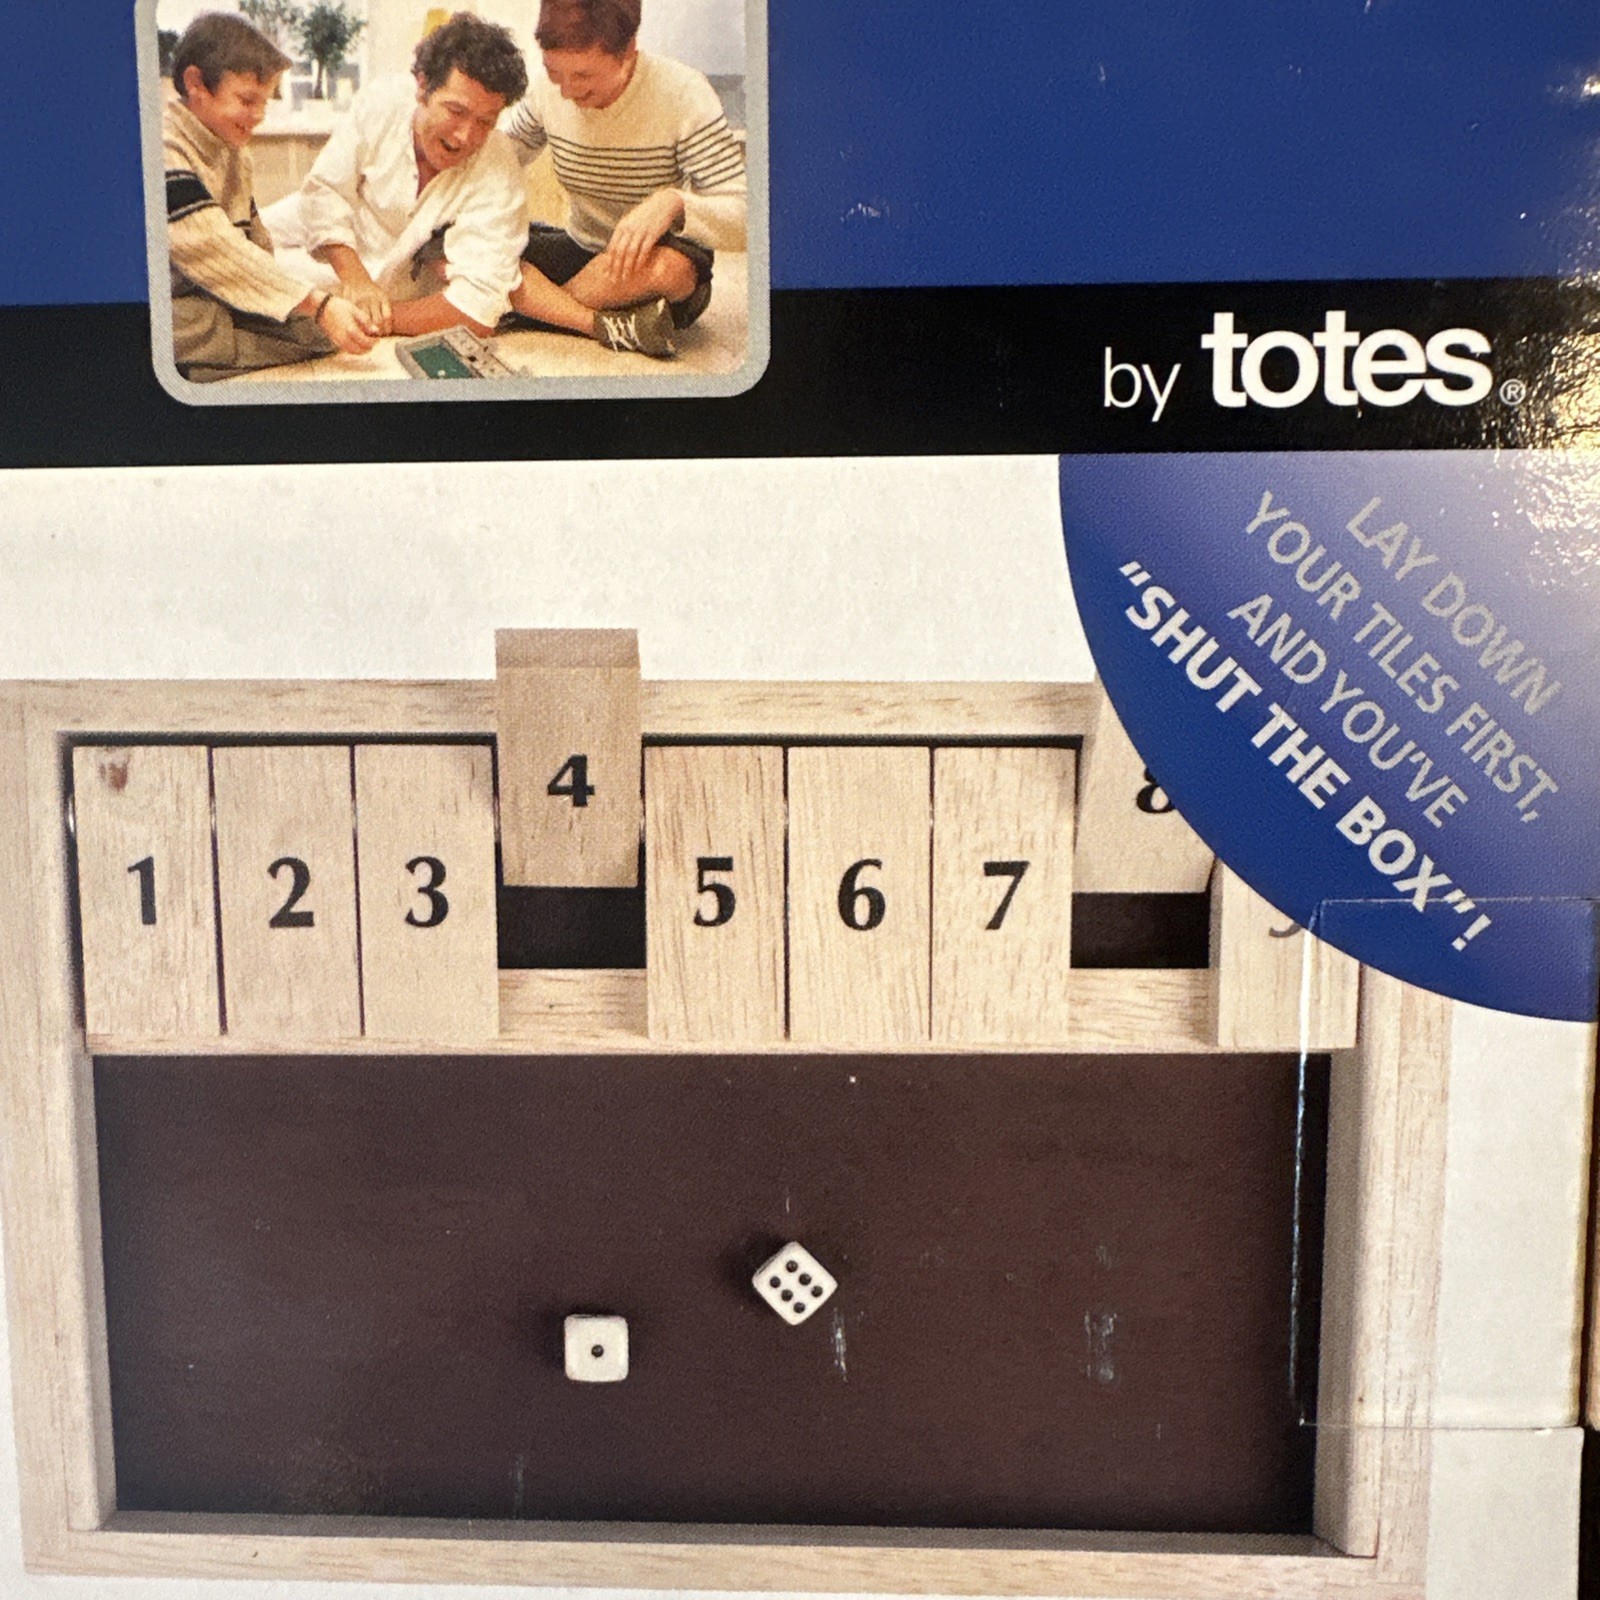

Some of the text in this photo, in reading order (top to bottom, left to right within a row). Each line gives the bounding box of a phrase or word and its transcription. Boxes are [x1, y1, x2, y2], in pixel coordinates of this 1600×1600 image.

[1103, 346, 1182, 423] by
[1345, 496, 1562, 716] LAY DOWN
[1244, 490, 1560, 823] YOUR TILES FIRST,
[1227, 593, 1470, 829] AND YOU'VE
[547, 753, 595, 808] 4
[1250, 702, 1352, 810] THE
[127, 856, 157, 926] 1
[267, 856, 315, 928] 2
[404, 856, 449, 928] 3
[693, 856, 736, 928] 5
[837, 858, 886, 931] 6
[982, 859, 1030, 931] 7
